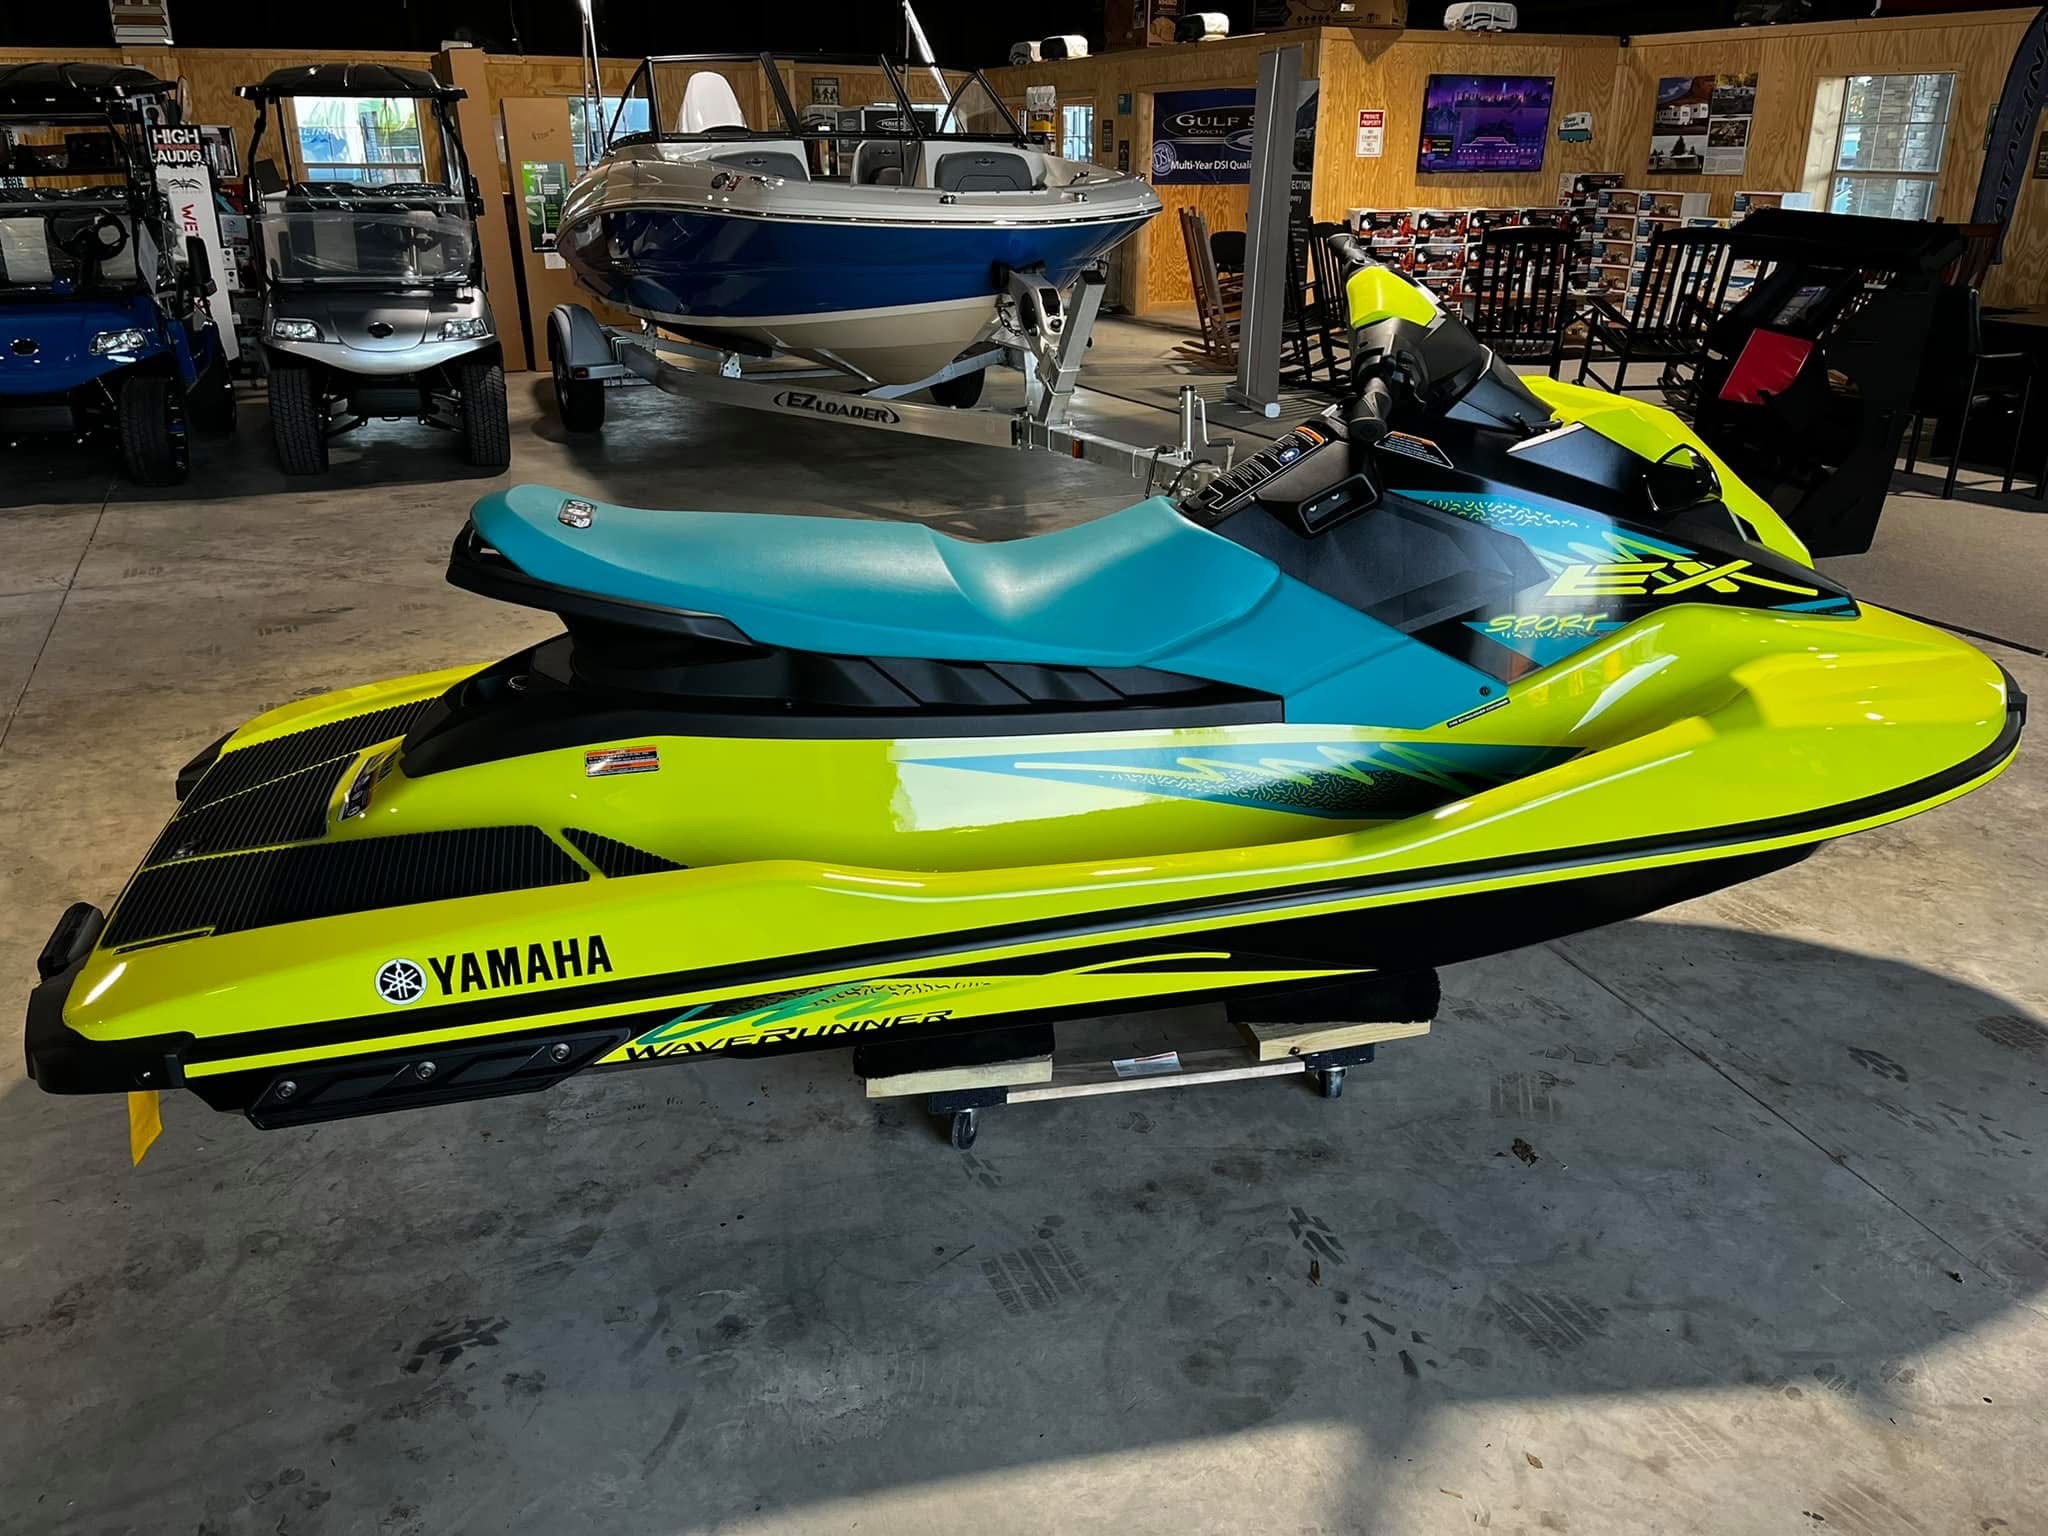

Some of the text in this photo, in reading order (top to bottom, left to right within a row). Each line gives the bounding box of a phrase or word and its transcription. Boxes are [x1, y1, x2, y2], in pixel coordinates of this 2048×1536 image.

[1176, 114, 1240, 127] GULF
[152, 129, 200, 144] HIGH
[157, 150, 202, 162] AUDIO
[1170, 159, 1212, 170] Multi-Year
[1214, 160, 1229, 170] DSI
[1290, 180, 1311, 190] ECTION
[1545, 559, 1752, 597] EX
[1485, 612, 1608, 632] SPORT
[428, 935, 613, 995] YAMAHA
[626, 1009, 953, 1061] WAVERUNNER
